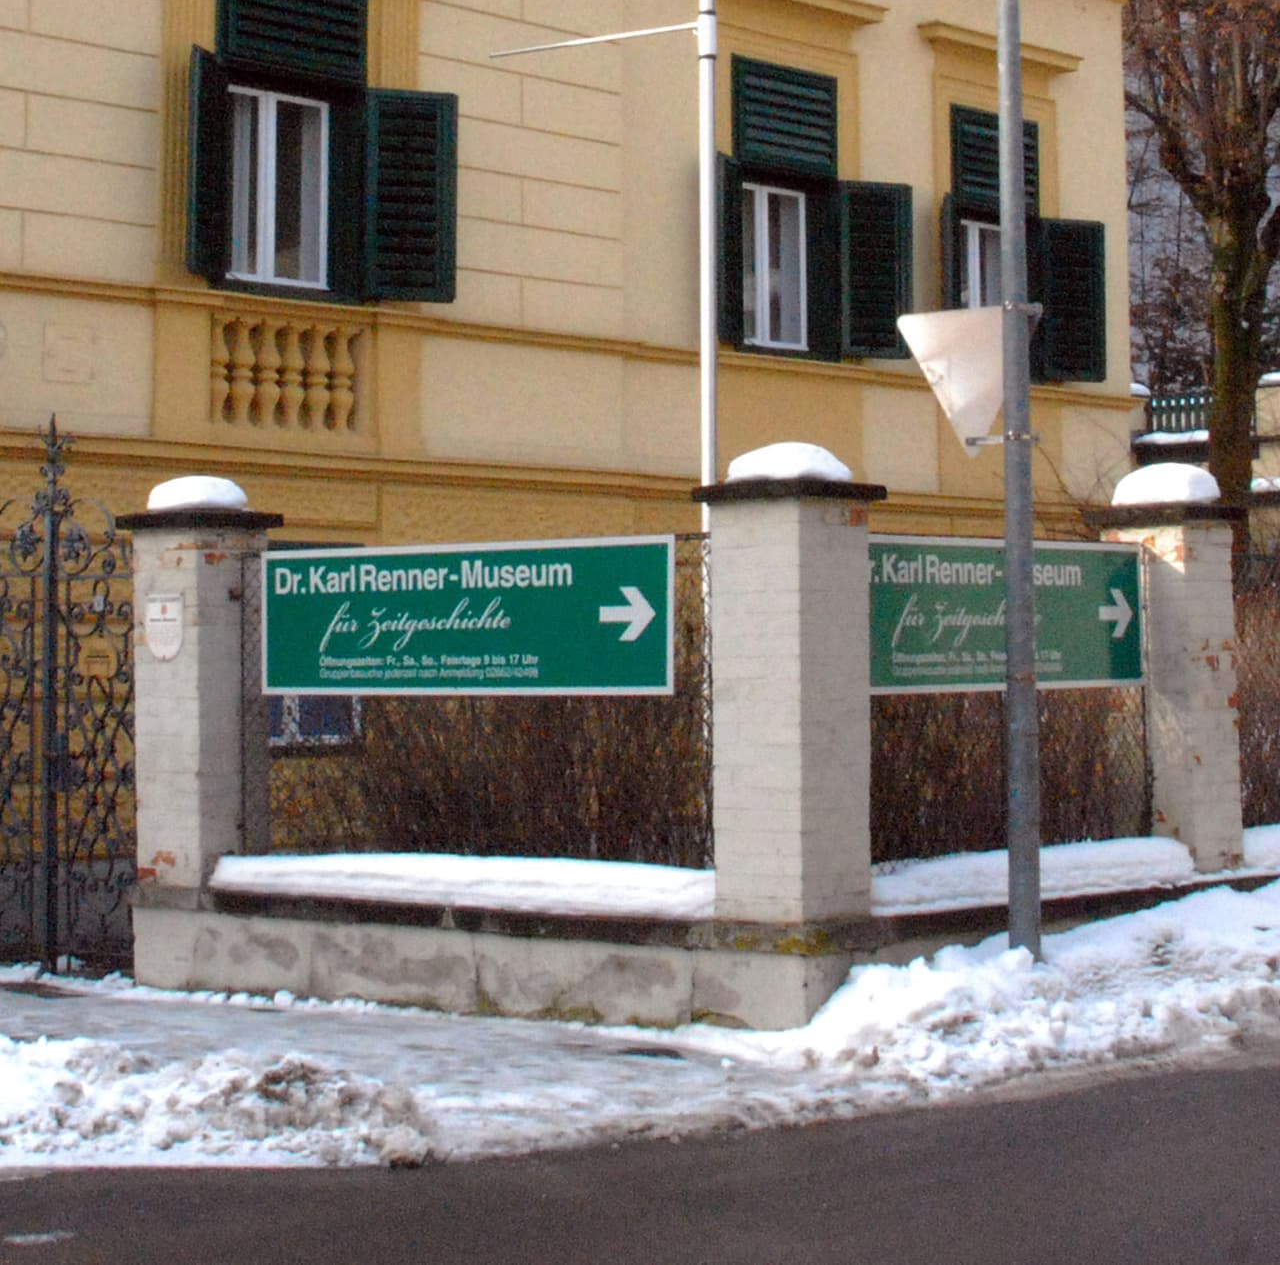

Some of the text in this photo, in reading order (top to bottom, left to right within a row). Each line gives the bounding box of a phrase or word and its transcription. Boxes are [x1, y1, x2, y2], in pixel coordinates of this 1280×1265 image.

[274, 568, 306, 595] Dr.
[310, 565, 355, 594] Karl
[882, 554, 922, 584] Karl
[319, 596, 512, 653] für Zeitgeschichte
[509, 653, 520, 665] 17
[522, 653, 539, 665] Uhr
